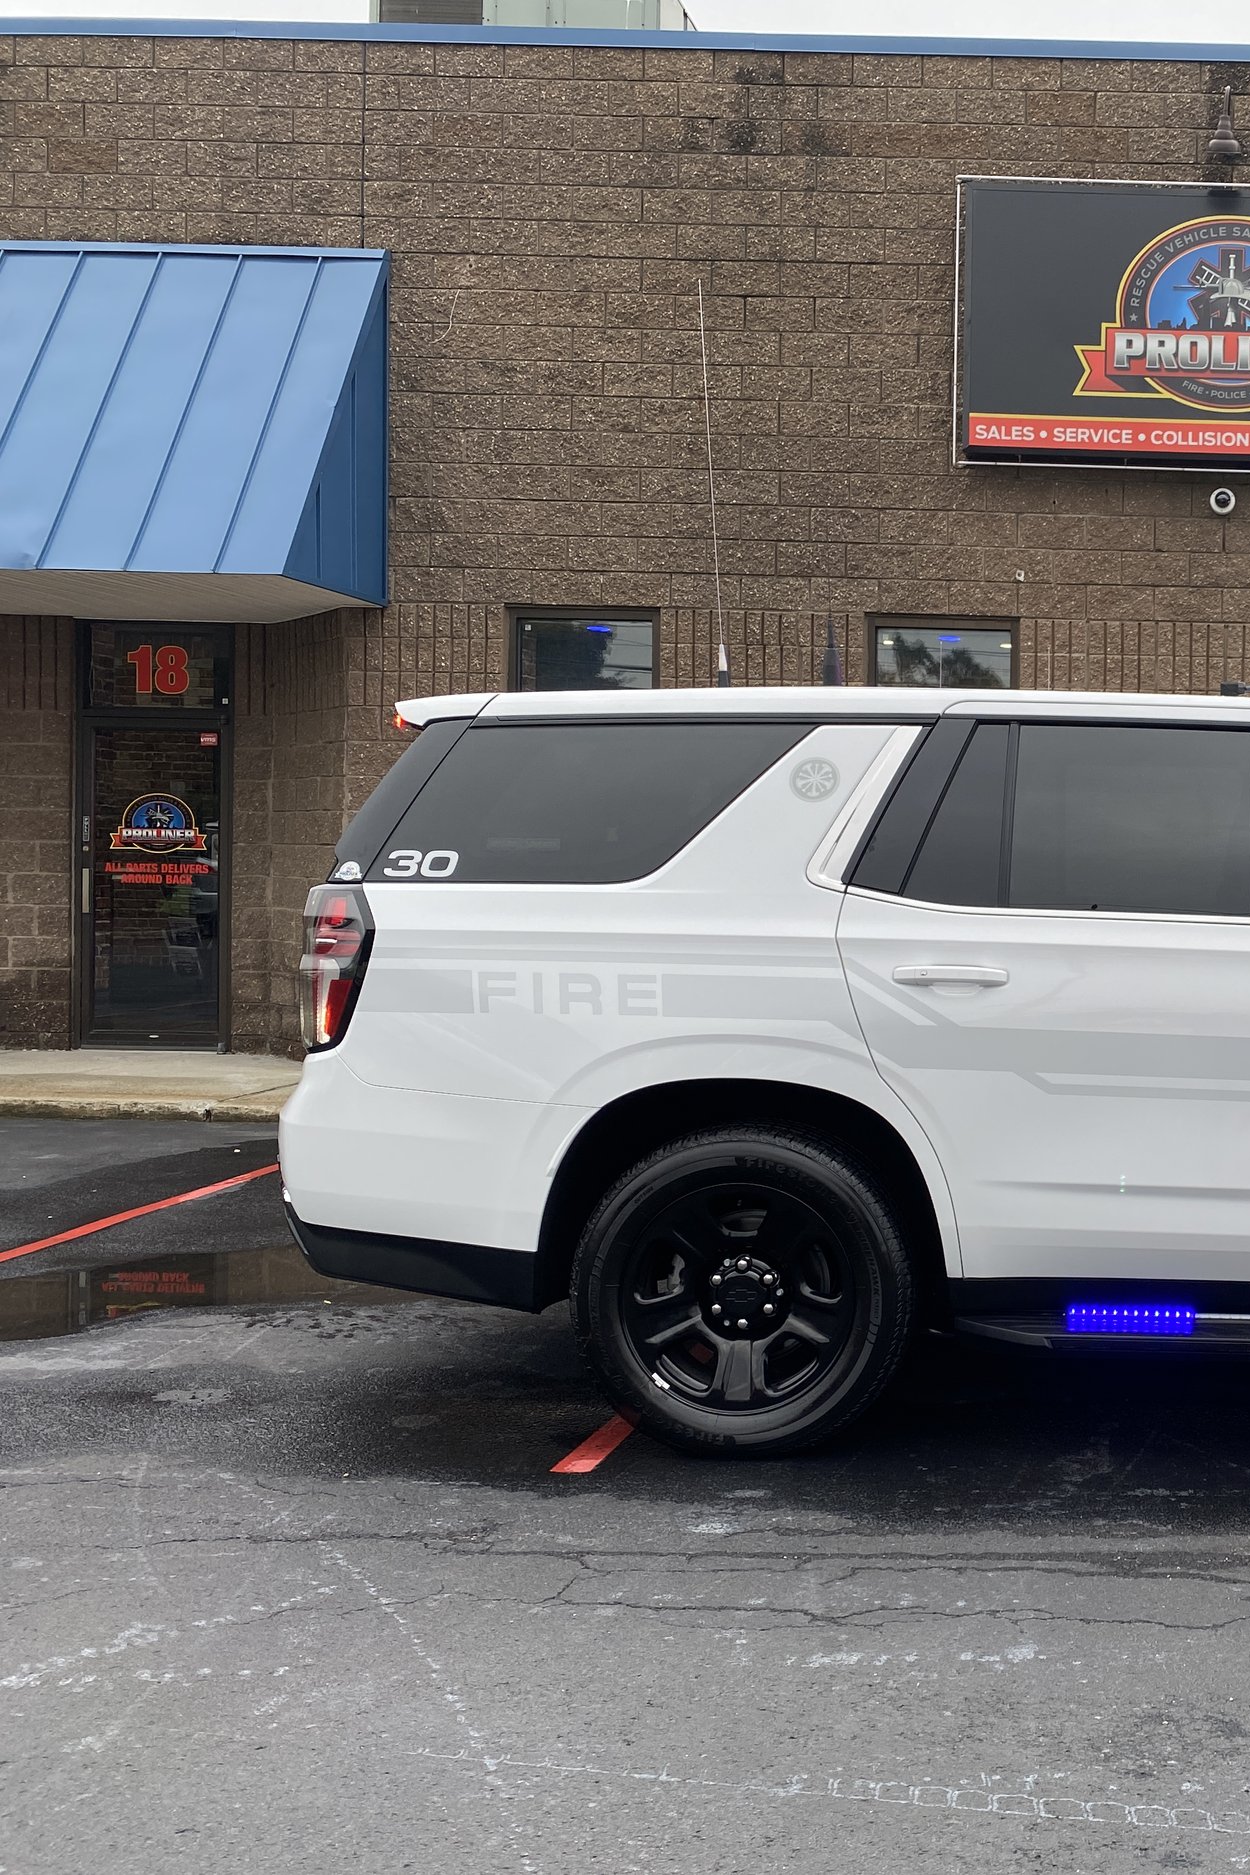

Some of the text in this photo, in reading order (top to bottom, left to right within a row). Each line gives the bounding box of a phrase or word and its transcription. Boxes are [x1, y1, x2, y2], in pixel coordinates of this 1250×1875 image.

[1130, 252, 1165, 307] RESCUE
[1165, 226, 1227, 253] VEHICLE
[1182, 380, 1204, 395] FIRE
[1210, 390, 1247, 399] POLICE
[975, 424, 1035, 441] SALES
[1053, 427, 1133, 444] SERVICE
[1151, 430, 1249, 447] COLLISION
[128, 645, 189, 694] 18
[122, 828, 196, 841] PROLINER
[105, 863, 121, 872] ALL
[161, 863, 209, 874] DELIVERS
[383, 849, 459, 878] 30
[166, 874, 193, 885] BACK
[478, 971, 658, 1016] FIRE
